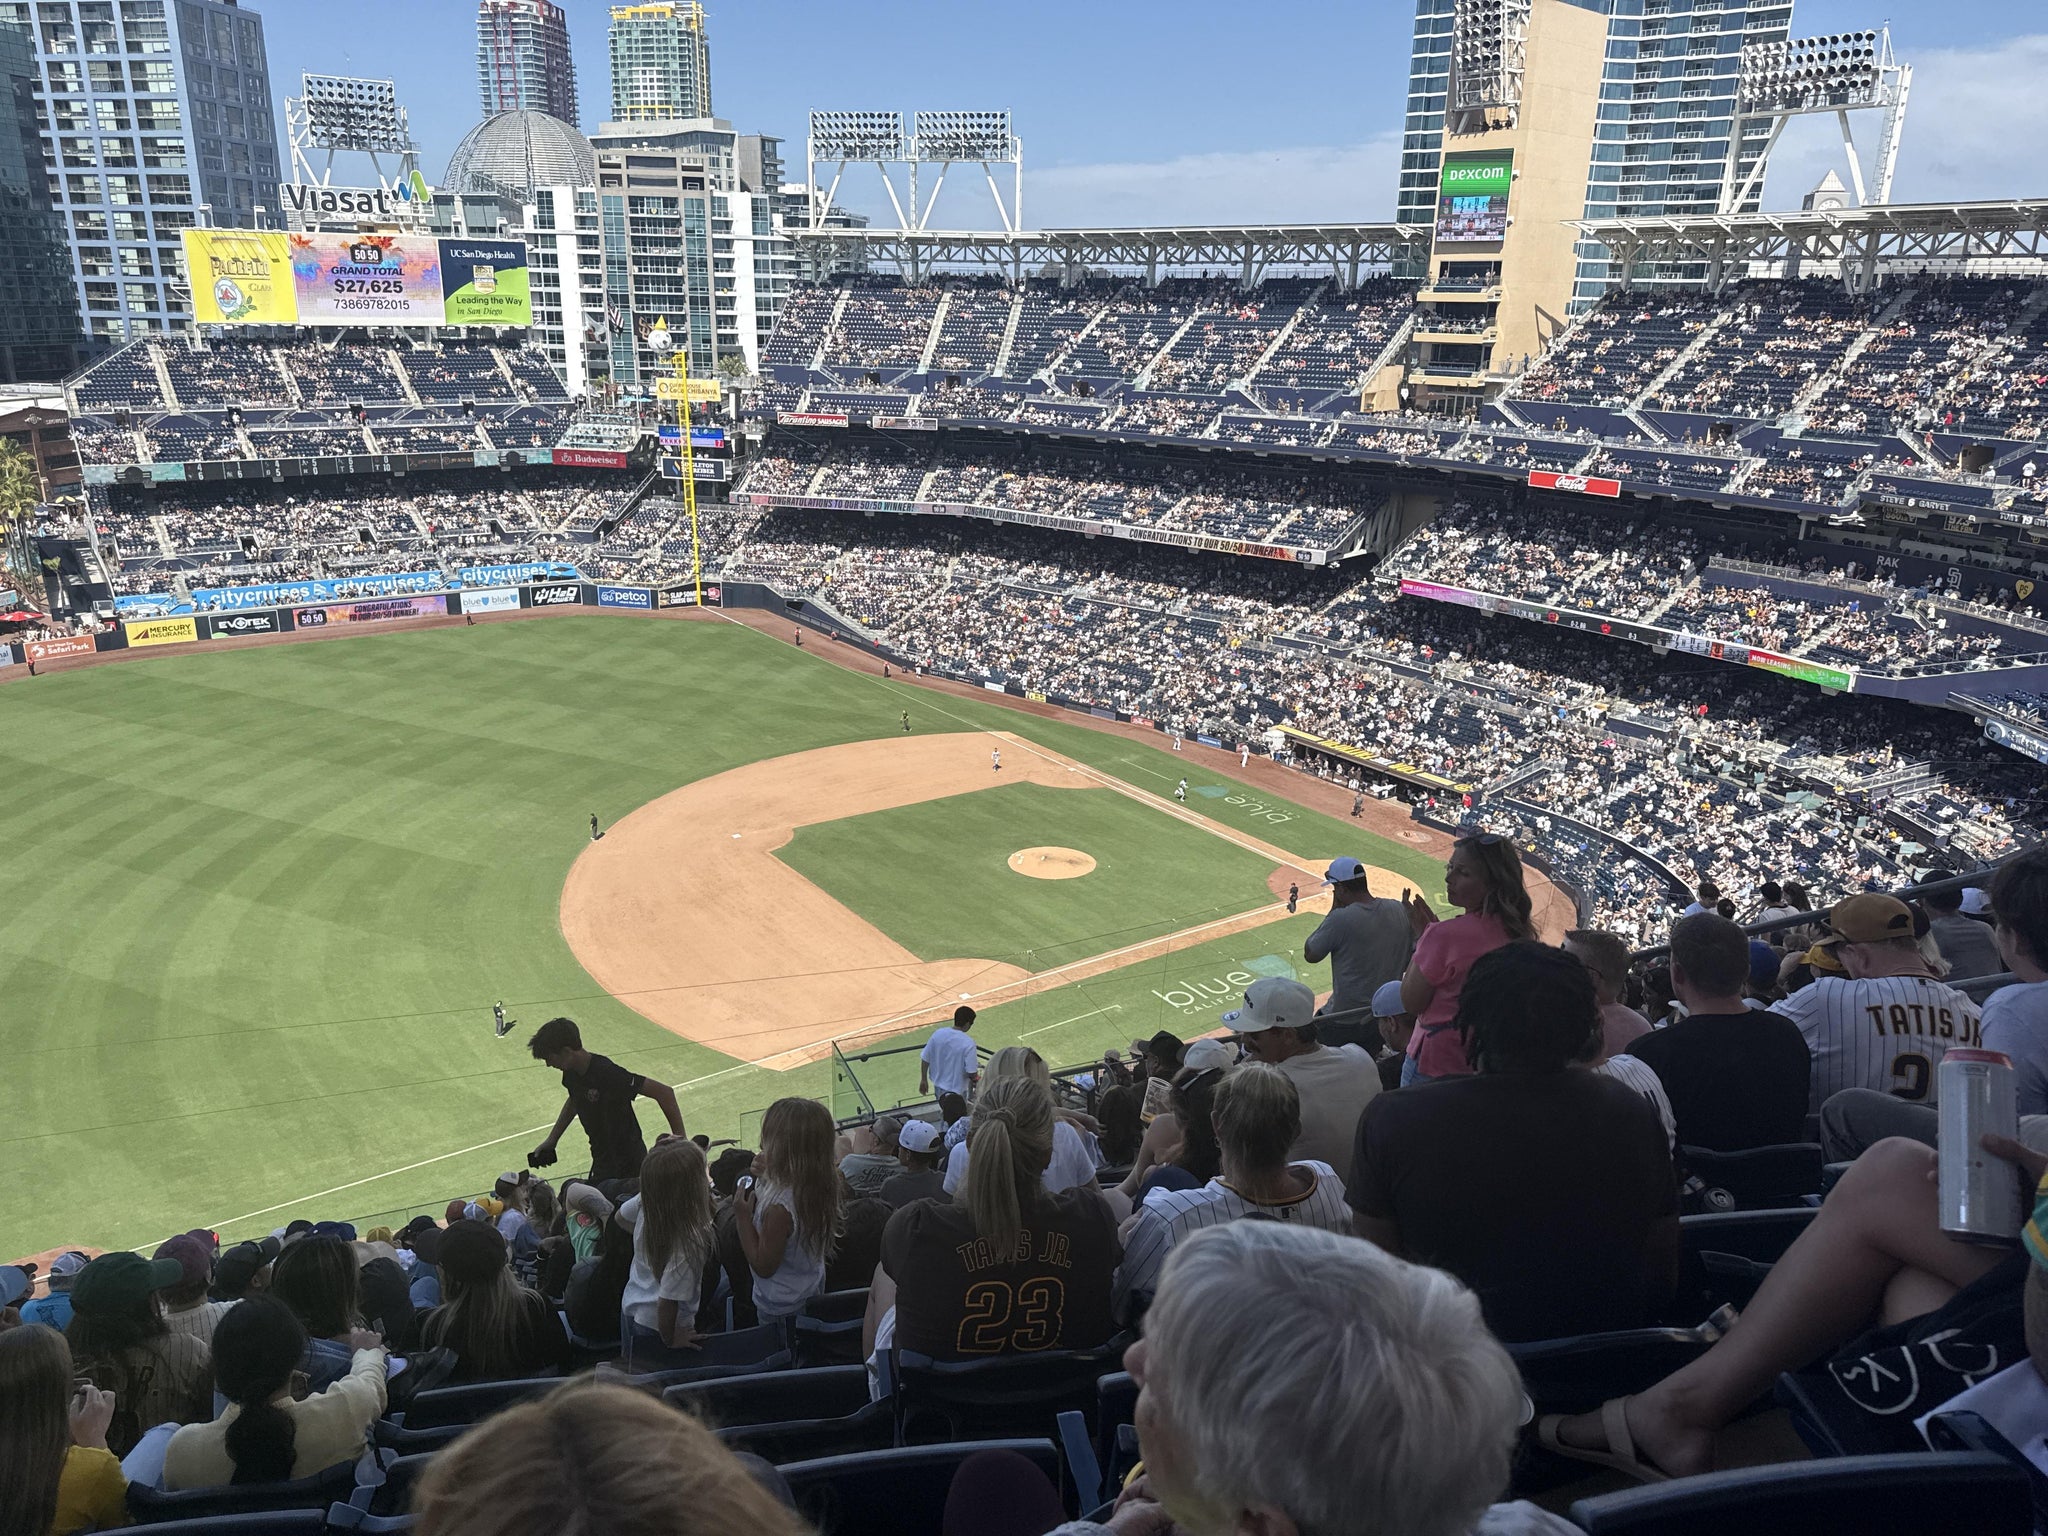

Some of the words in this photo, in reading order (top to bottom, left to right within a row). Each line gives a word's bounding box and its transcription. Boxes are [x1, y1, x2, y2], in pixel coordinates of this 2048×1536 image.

[285, 183, 391, 214] Viasat
[354, 249, 366, 260] 50
[367, 249, 379, 260] 50
[450, 248, 462, 258] UC
[462, 249, 475, 259] San
[474, 250, 494, 260] Diego
[494, 250, 516, 260] Health
[331, 266, 371, 275] GRAND
[372, 267, 405, 276] TOTAL
[334, 278, 404, 295] $27,625
[333, 299, 410, 310] 73869782015
[456, 296, 490, 306] Leading
[490, 296, 504, 304] the
[505, 297, 523, 307] Way
[467, 307, 481, 315] San
[483, 308, 503, 316] Diego
[575, 454, 618, 465] Budweiser
[1554, 474, 1589, 491] Coca-Cola
[767, 495, 833, 508] CONGRATULATIONS
[834, 499, 843, 508] TO
[844, 500, 860, 509] OUR
[860, 500, 882, 511] 50/50
[883, 501, 915, 512] WINNER!
[1880, 494, 1905, 505] STEVE
[1918, 500, 1951, 512] GARVEY
[963, 505, 1016, 521] CONGRATULATIONS
[1017, 512, 1025, 521] TO
[1025, 513, 1038, 523] OUR
[1039, 516, 1058, 527] 50/50
[1058, 519, 1086, 531] WINNER!
[2021, 514, 2034, 525] 19
[1129, 528, 1192, 546] CONGRATULATIONS
[1193, 537, 1203, 547] TO
[1203, 538, 1219, 549] OUR
[1219, 540, 1244, 553] 50/50
[1244, 543, 1278, 558] WINNER!
[1876, 555, 1900, 568] RAK
[462, 563, 547, 583] citycruises
[210, 584, 311, 607] citycruises
[463, 596, 481, 606] blue
[491, 593, 510, 604] blue
[615, 589, 648, 603] petco
[354, 600, 412, 613] CONGRATULATIONS
[301, 615, 311, 624] 50
[313, 613, 324, 623] 50
[349, 612, 357, 622] TO
[357, 611, 371, 621] OUR
[371, 610, 392, 620] 50/50
[392, 607, 420, 618] WINNER!
[150, 623, 192, 634] MERCURY
[150, 629, 193, 638] INSURANCE
[47, 645, 71, 655] Safari
[71, 642, 90, 652] Park
[1751, 655, 1766, 664] NOW
[1766, 657, 1792, 671] LEASING
[1224, 795, 1293, 825] blue
[1151, 971, 1257, 1009] blue
[1183, 988, 1247, 1015] CALIFOR
[1866, 1004, 1952, 1038] TATIS
[1038, 1231, 1073, 1270] JR.
[956, 1276, 1065, 1353] 23
